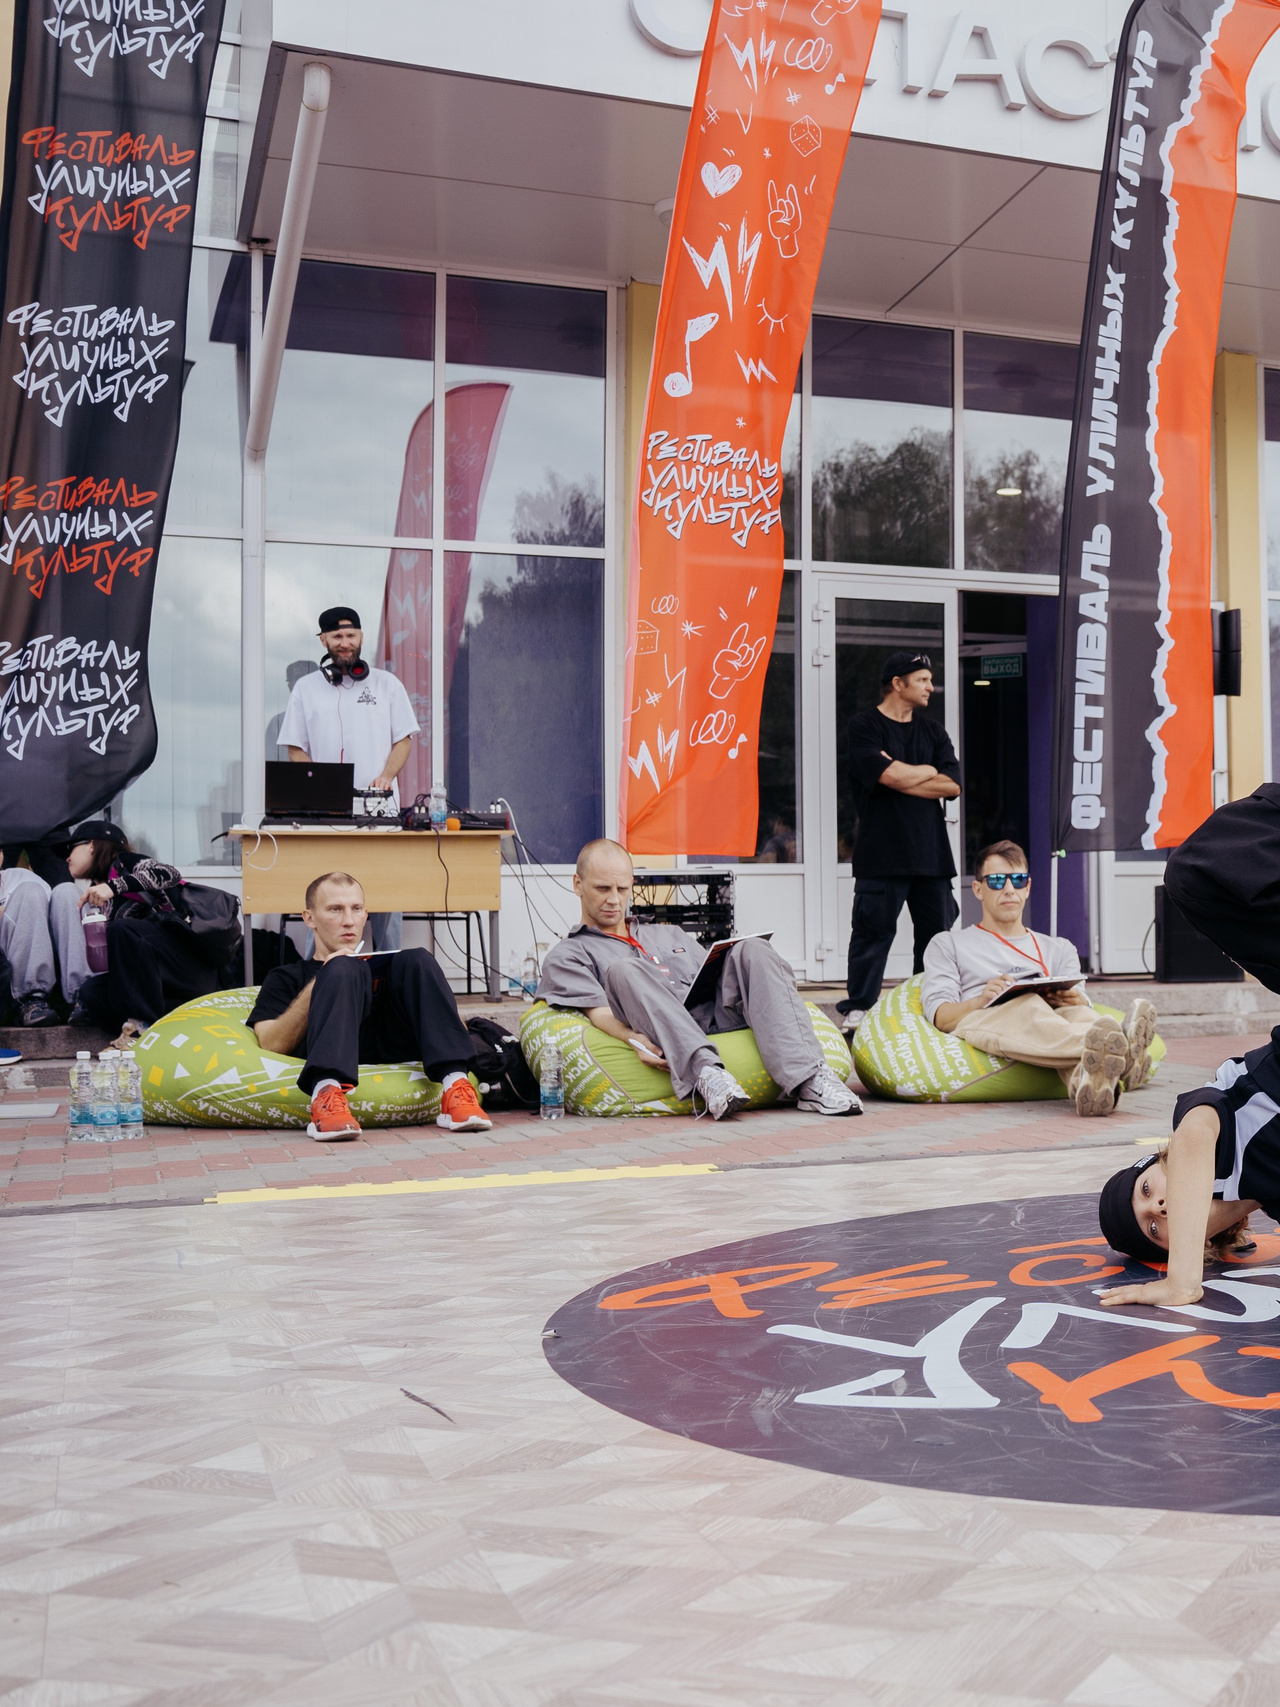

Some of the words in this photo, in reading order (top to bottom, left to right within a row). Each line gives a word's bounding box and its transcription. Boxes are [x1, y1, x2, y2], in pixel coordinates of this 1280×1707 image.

[58, 18, 204, 79] КУЛЬТУР
[22, 126, 195, 167] ФЕСТИВАЛЬ
[1111, 30, 1157, 250] КУЛЬТУР
[28, 159, 191, 214] УЛИЧНЫХ
[44, 196, 191, 251] КУЛЬТУР
[7, 302, 175, 338] ФЕСТИВАЛЬ
[13, 336, 169, 389] УЛИЧНЫХ
[1086, 264, 1126, 497] УЛИЧНЫХ
[28, 368, 168, 427] КУЛЬТУР
[642, 461, 779, 510] УЛИЧНЫХ
[0, 506, 153, 565] УЛИЧНЫХ
[653, 491, 780, 548] КУЛЬТУР
[13, 541, 154, 599] КУЛЬТУР
[0, 668, 138, 709] ЛИЧНЫХ
[984, 664, 1020, 675] ВЫХОД
[1071, 523, 1112, 829] ФЕСТИВАЛЬ
[565, 1053, 594, 1083] урск
[894, 1032, 920, 1077] #Курск
[192, 1099, 244, 1125] урск
[582, 1075, 611, 1106] okursk
[591, 1087, 625, 1116] урск
